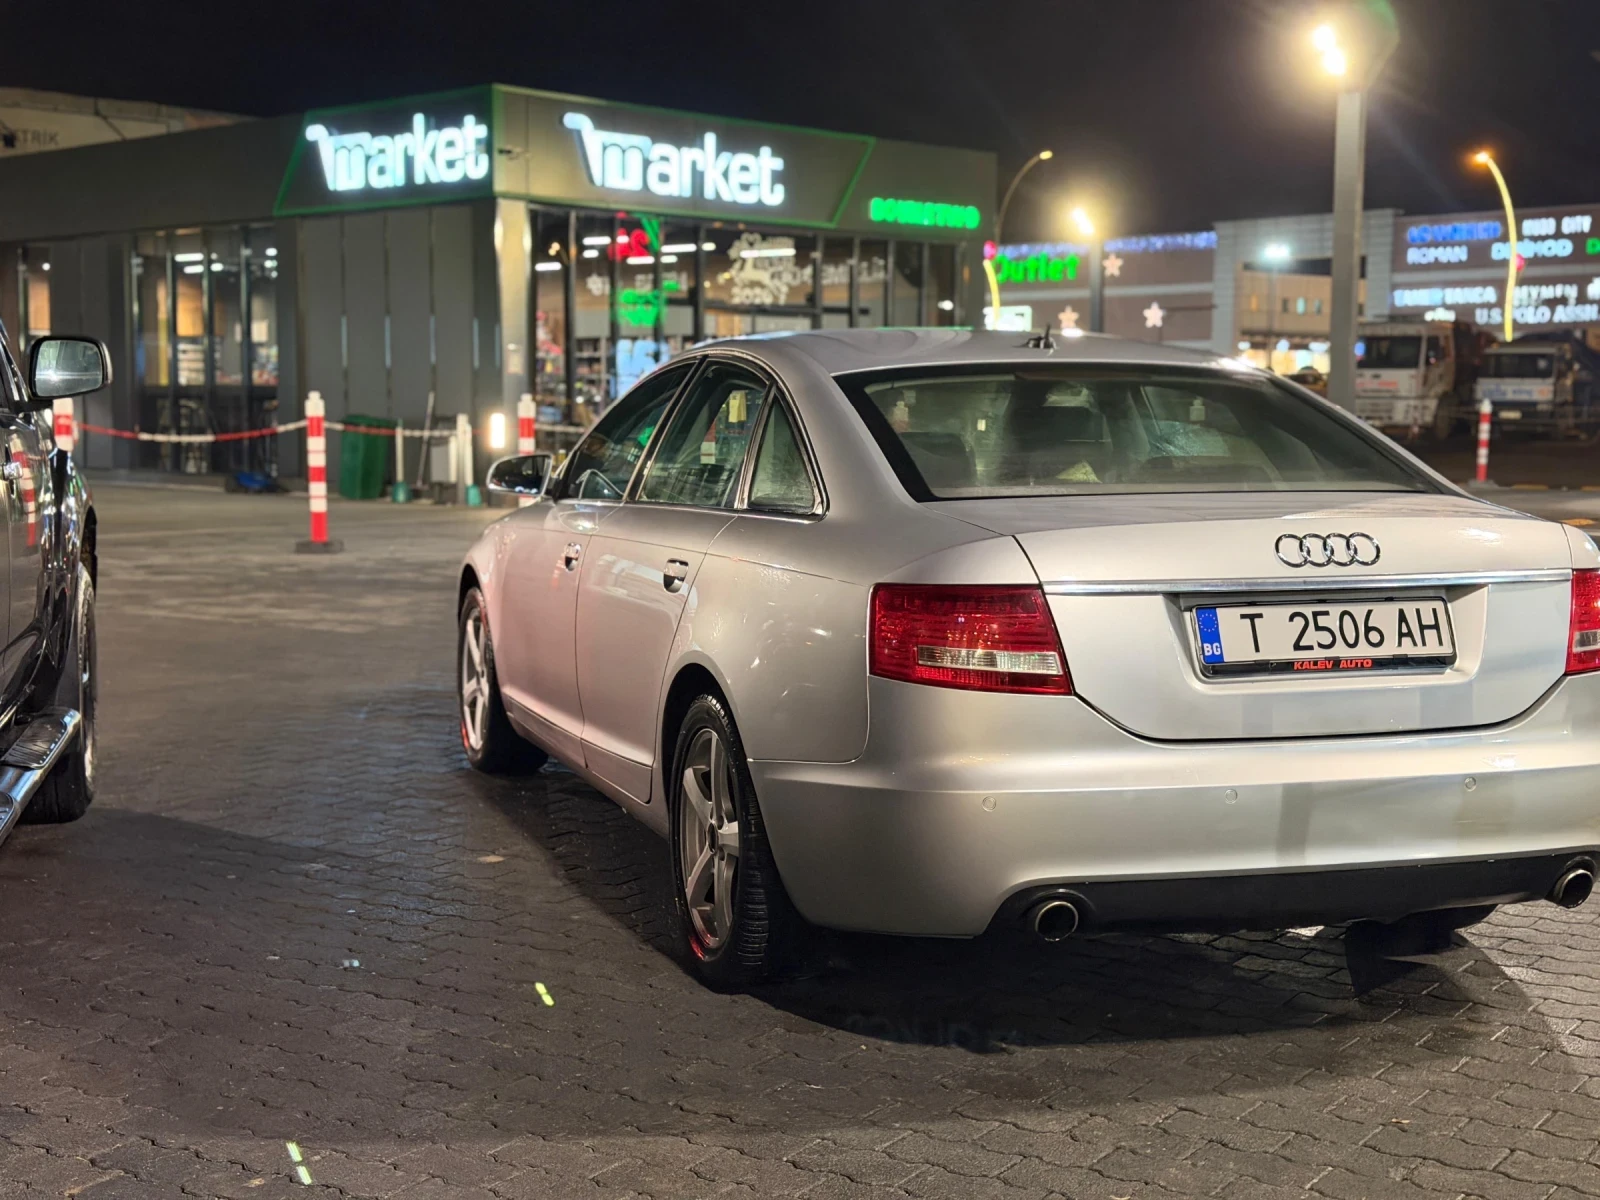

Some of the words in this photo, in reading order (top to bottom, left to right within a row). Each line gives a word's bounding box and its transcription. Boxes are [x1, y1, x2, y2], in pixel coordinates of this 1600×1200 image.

[305, 112, 489, 191] market
[563, 112, 785, 206] market
[1407, 245, 1468, 264] ROMAN
[1240, 613, 1263, 653] T
[1288, 609, 1385, 652] 2506
[1395, 607, 1444, 648] AH
[1204, 643, 1221, 656] BG
[1293, 658, 1333, 670] KALEV
[1339, 658, 1373, 669] AUTO
